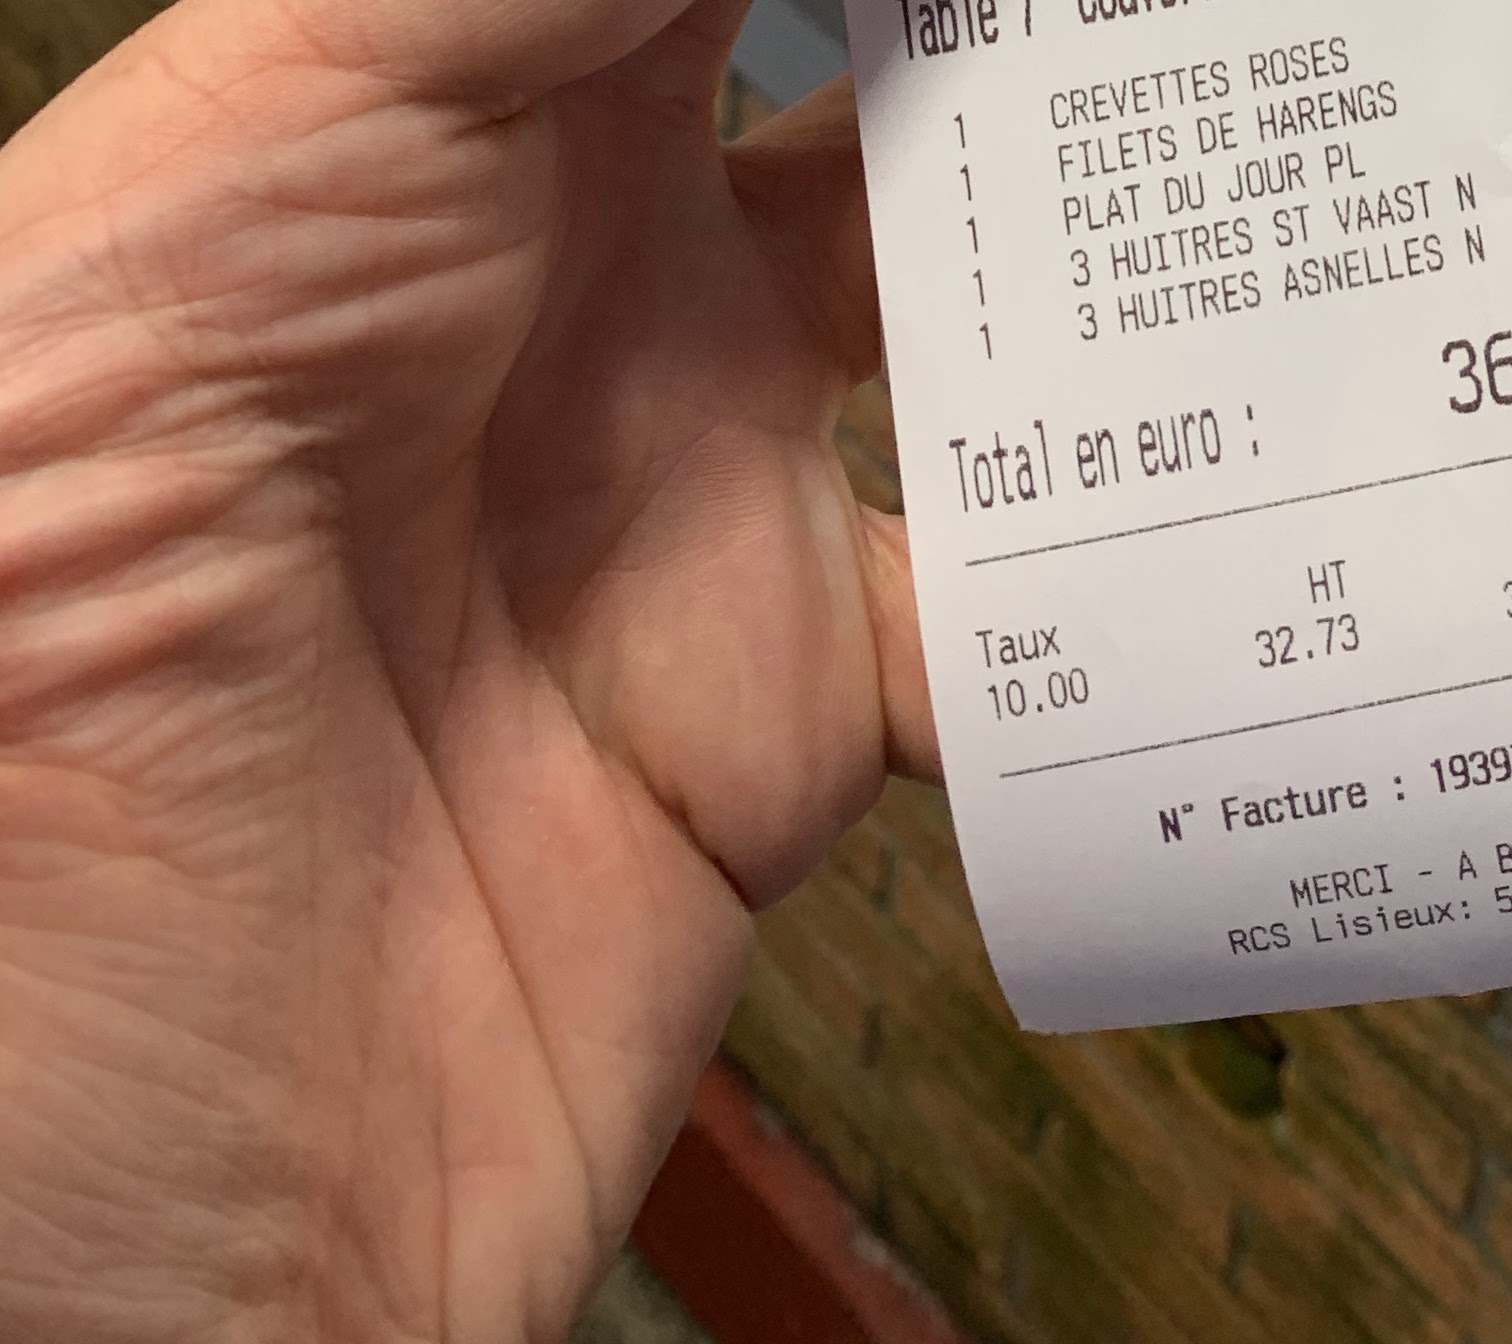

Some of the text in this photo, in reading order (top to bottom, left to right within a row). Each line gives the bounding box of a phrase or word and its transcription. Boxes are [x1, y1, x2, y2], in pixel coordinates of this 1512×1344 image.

[952, 111, 967, 149] 1
[1049, 60, 1231, 131] CREVETTES
[1247, 36, 1350, 92] ROSES
[959, 163, 973, 202] 1
[1057, 123, 1178, 183] FILETS
[1195, 110, 1239, 156] DE
[1256, 79, 1398, 144] HARENGS
[965, 215, 979, 255] 1
[1062, 182, 1141, 236] PLAT
[1163, 170, 1206, 216] DU
[1227, 151, 1307, 204] JOUR
[1323, 141, 1367, 185] PL
[972, 268, 986, 307] 1
[1069, 248, 1092, 288] 3
[1109, 216, 1254, 281] HUITRES
[1272, 203, 1310, 248] ST
[1332, 179, 1431, 236] VAAST
[1454, 171, 1477, 213] N
[978, 321, 993, 361] 1
[1077, 302, 1099, 342] 3
[1117, 269, 1262, 334] HUITRES
[1284, 233, 1445, 302] ASNELLES
[1463, 223, 1486, 266] N
[948, 418, 1054, 513] Total
[1075, 427, 1121, 490] en
[1136, 407, 1222, 478] euro
[974, 625, 1062, 669] Taux
[1306, 559, 1347, 604] HT
[986, 666, 1090, 722] 10.00
[1254, 612, 1360, 669] 32.73
[1220, 781, 1368, 832] Facture
[1226, 922, 1291, 955] RCS
[1310, 900, 1471, 944] Lisieux:
[1289, 863, 1394, 910] MERCI
[1458, 849, 1479, 881] A
